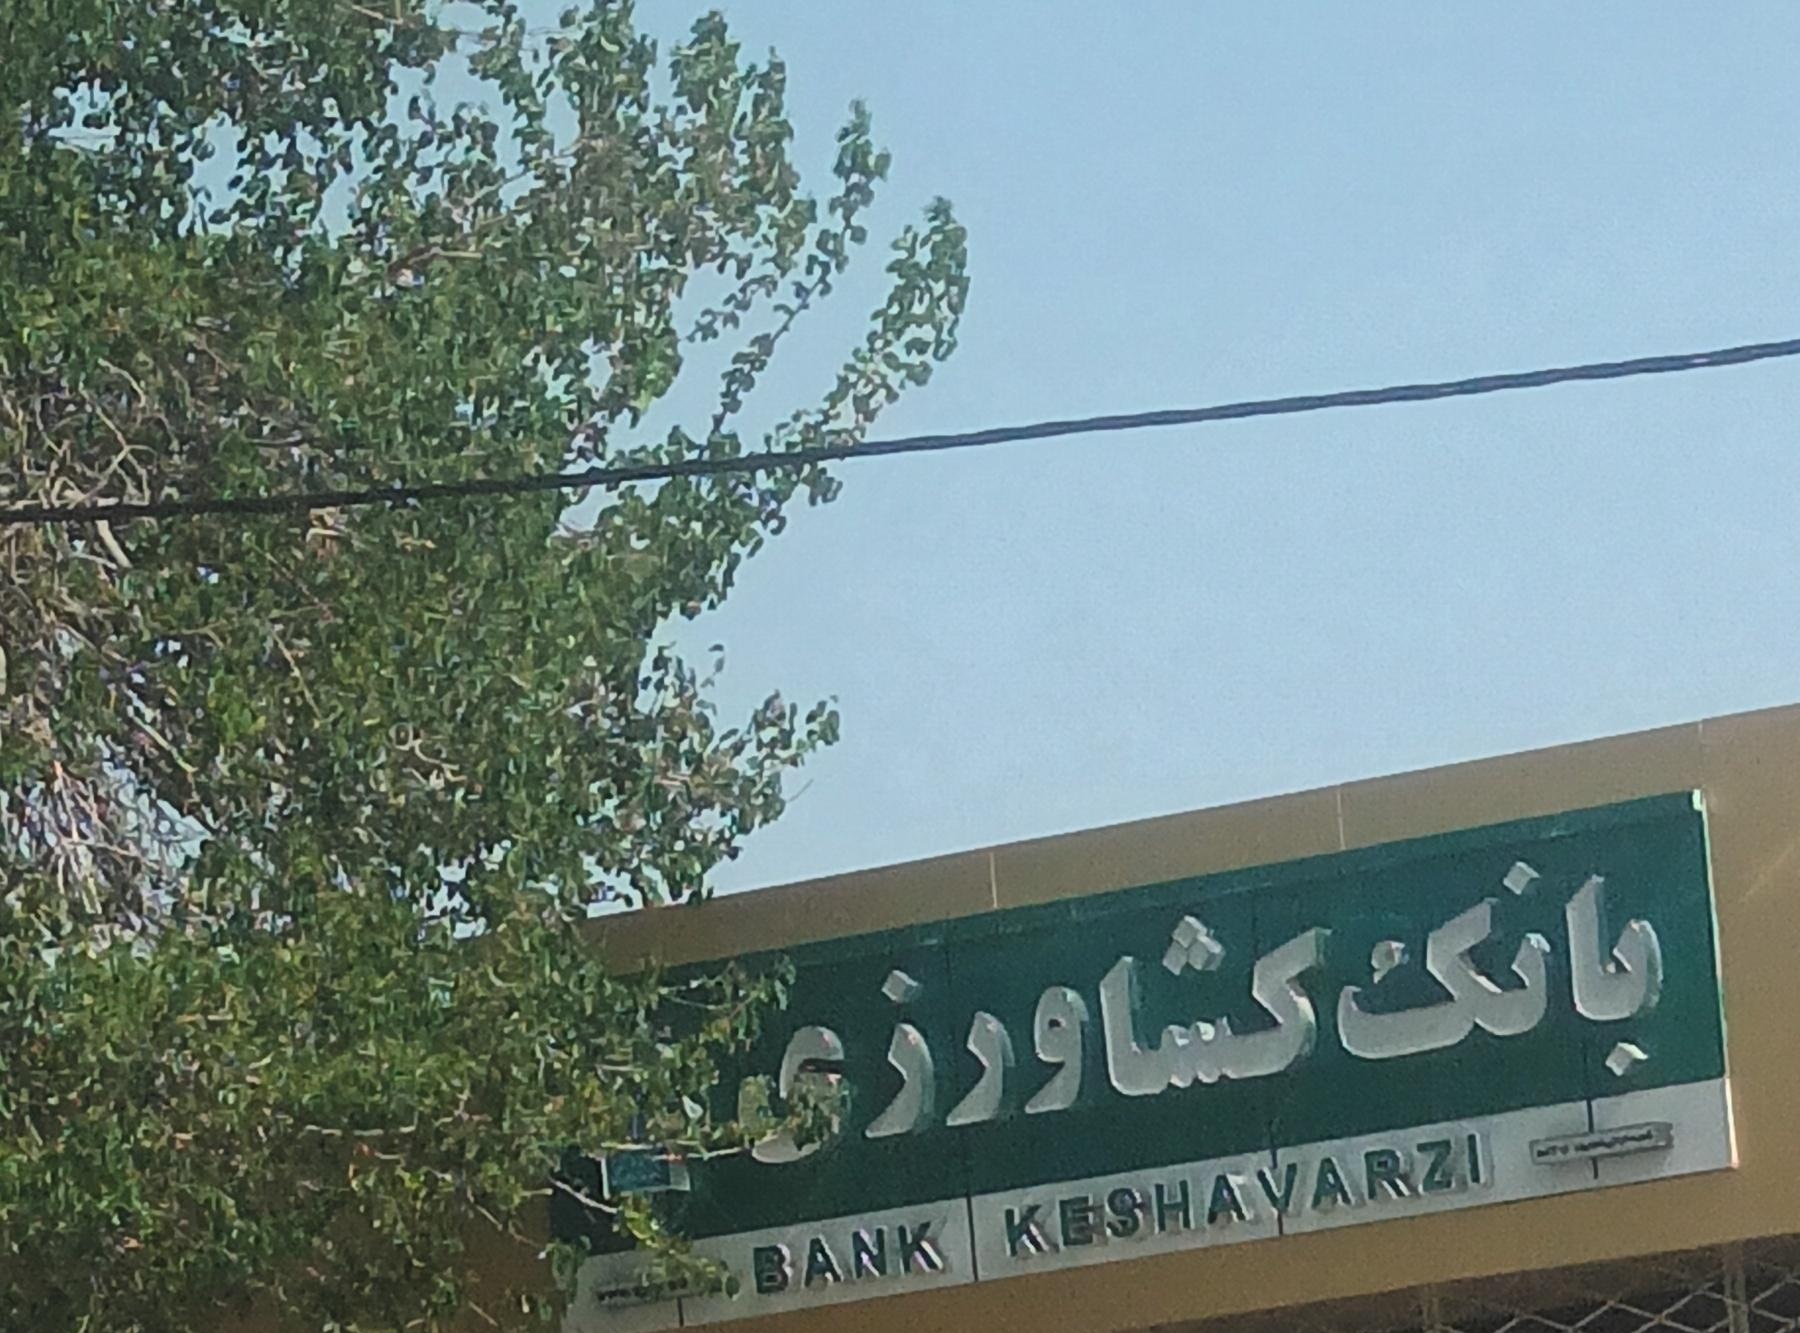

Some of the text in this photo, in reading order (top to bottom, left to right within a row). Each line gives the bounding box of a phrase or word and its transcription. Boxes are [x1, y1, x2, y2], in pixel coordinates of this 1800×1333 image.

[738, 861, 1663, 1165] بانک کشاورزی
[752, 1132, 1492, 1295] BANK KESHAVARZI
